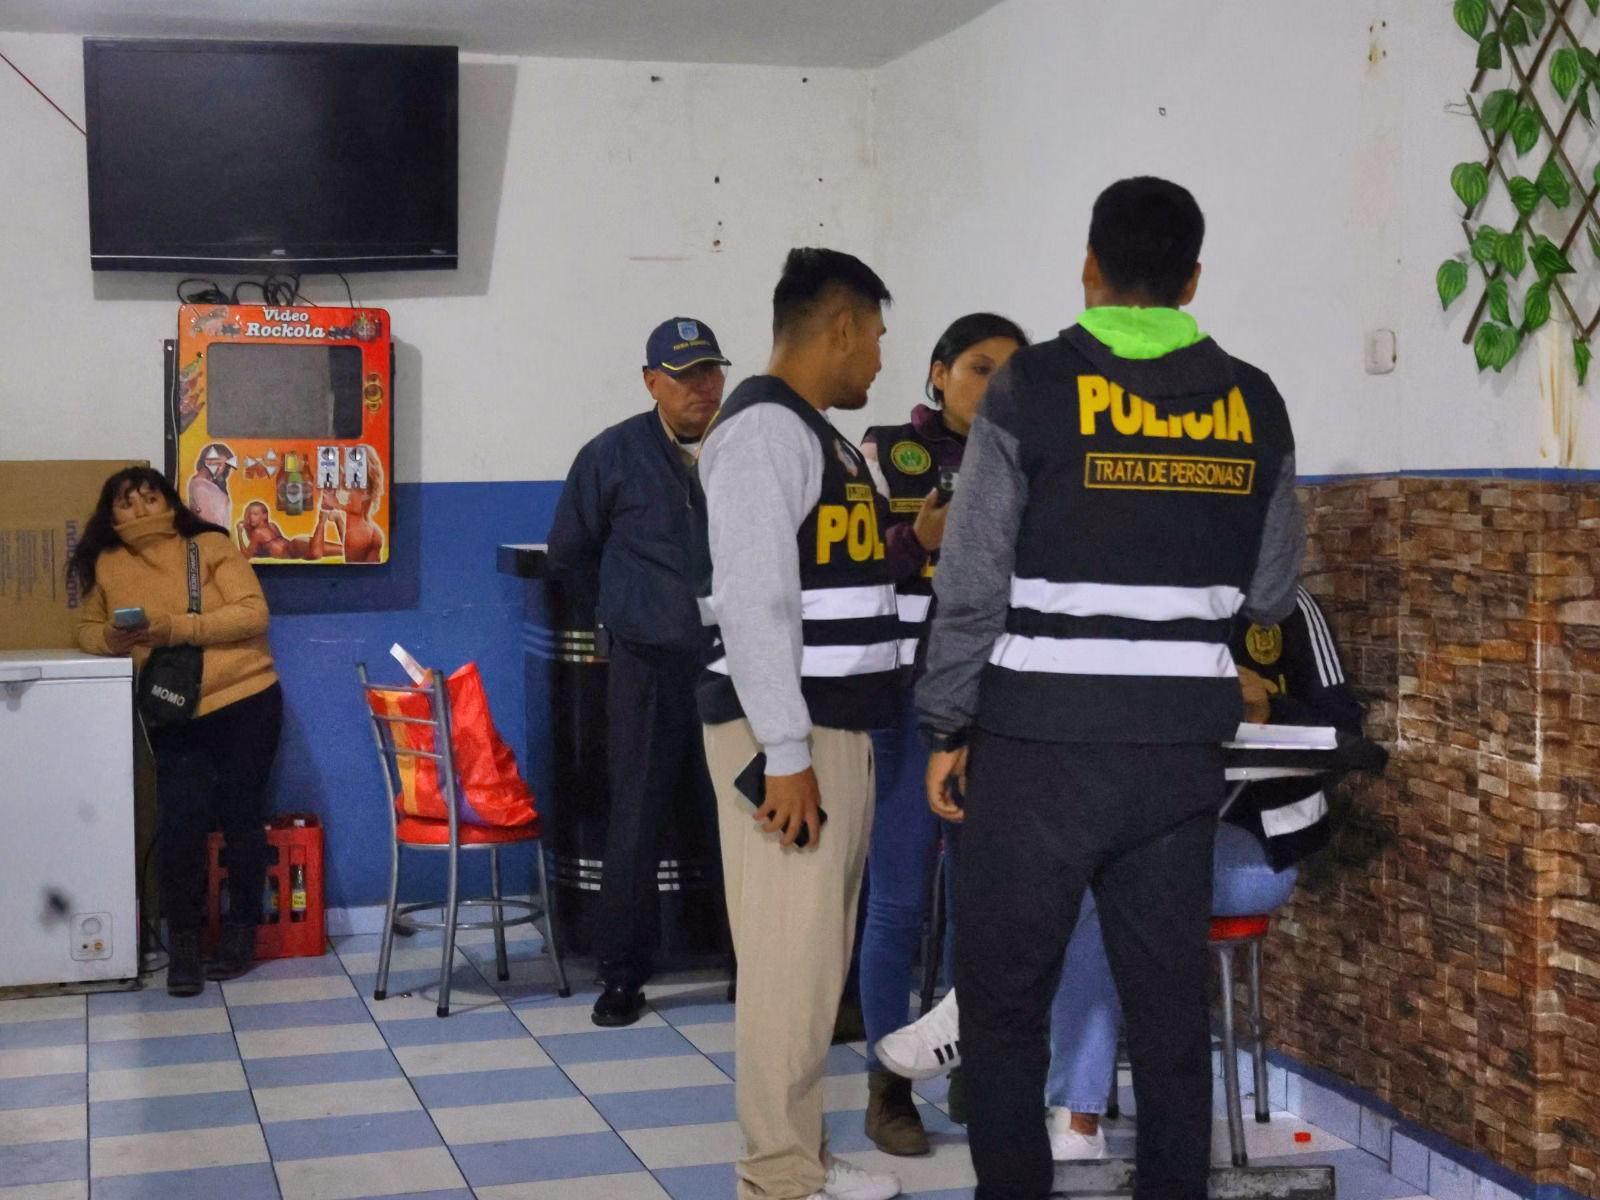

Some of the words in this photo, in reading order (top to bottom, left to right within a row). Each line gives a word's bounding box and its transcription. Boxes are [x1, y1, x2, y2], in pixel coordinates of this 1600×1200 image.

[263, 307, 309, 321] Video
[245, 322, 326, 339] Rockola
[1095, 459, 1145, 482] TRATA
[1148, 461, 1168, 483] DE
[1170, 463, 1245, 487] PERSONAS
[151, 684, 186, 707] MOMO
